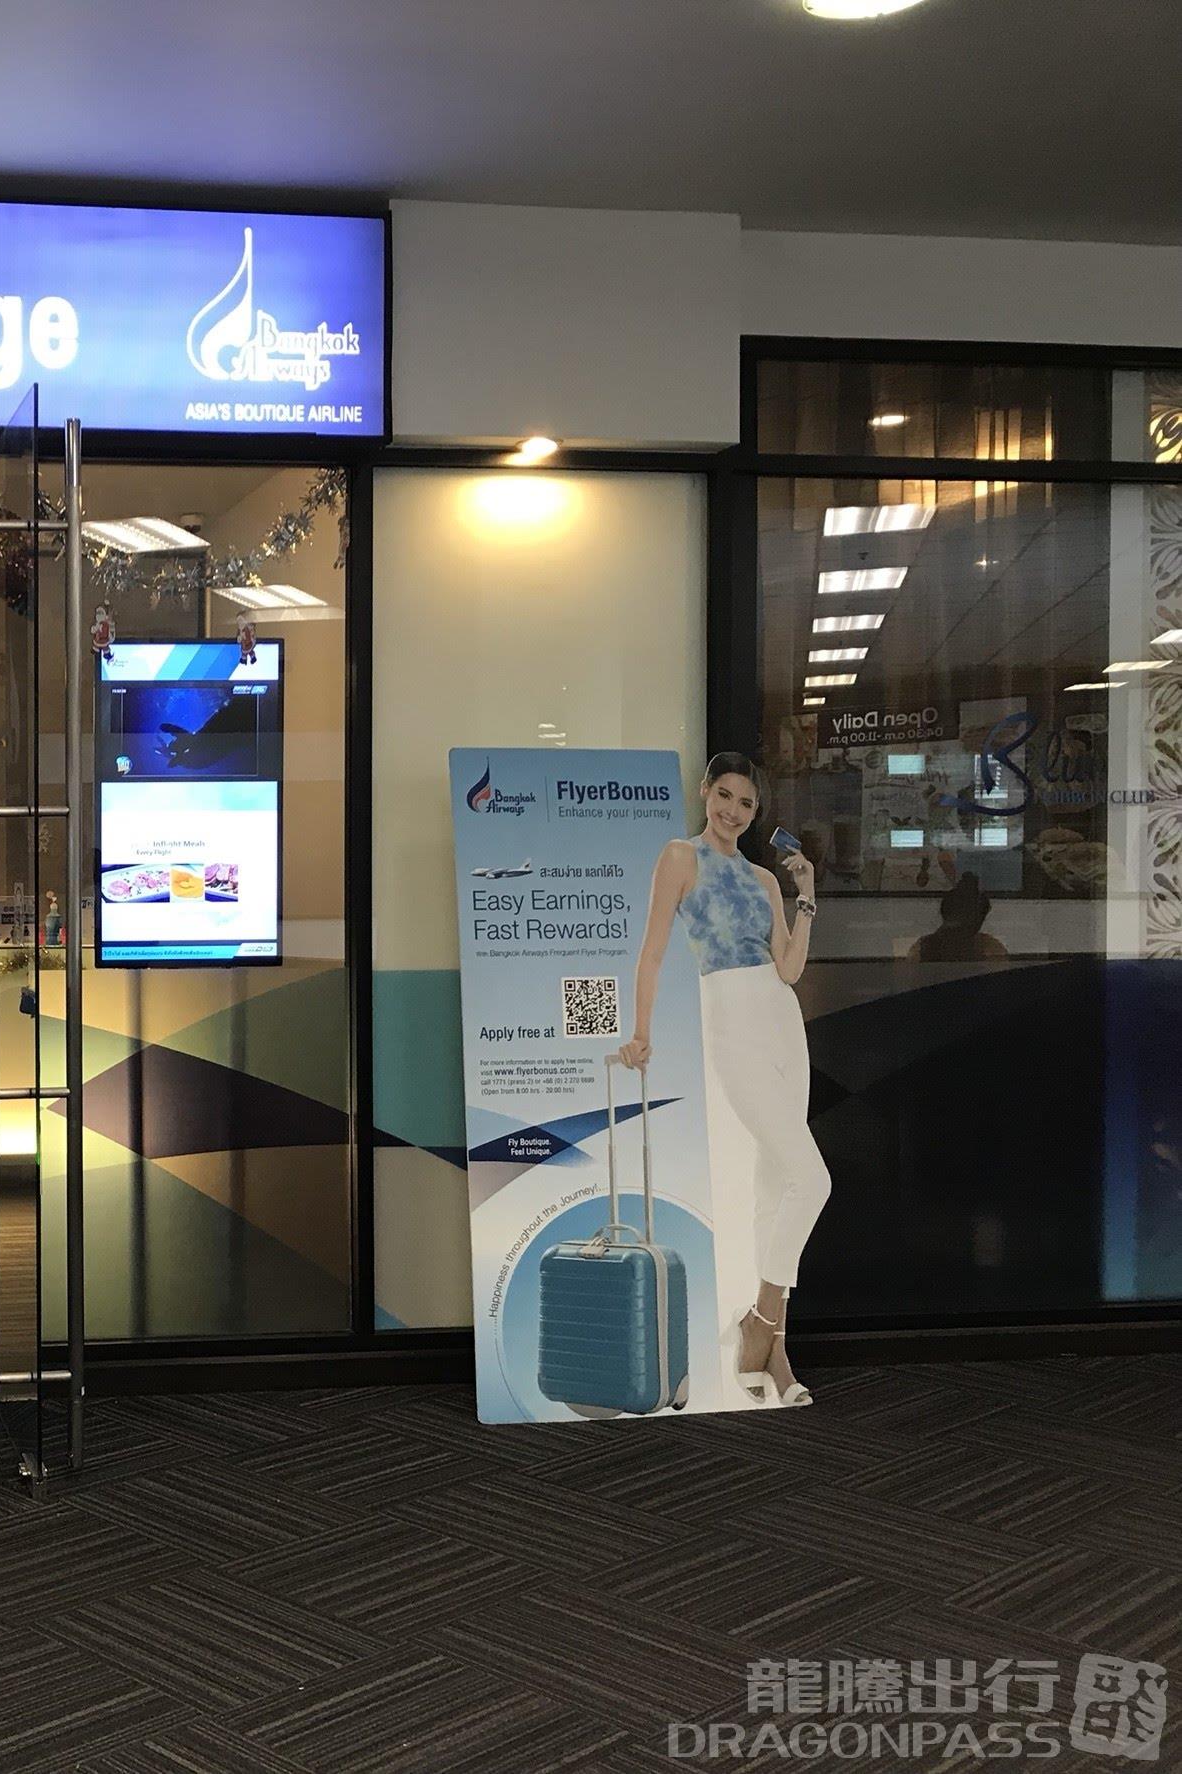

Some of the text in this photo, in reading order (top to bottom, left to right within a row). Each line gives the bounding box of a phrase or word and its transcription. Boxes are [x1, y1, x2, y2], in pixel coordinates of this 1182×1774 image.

[257, 310, 360, 355] Bangkok
[186, 403, 362, 422] ASIA'S BOUTIQUE AIRLINE
[495, 788, 536, 806] Bangkok
[557, 780, 670, 804] FlyerBonus
[486, 800, 525, 816] Airways
[559, 807, 671, 820] Enhance your journey
[472, 890, 631, 915] Easy Earnings,
[474, 919, 629, 940] Fast Rewards!
[480, 1026, 555, 1041] Apply free at
[520, 1138, 552, 1146] Boutique.
[526, 1148, 552, 1156] Unique.
[506, 1215, 544, 1261] throughout
[542, 1203, 558, 1218] the
